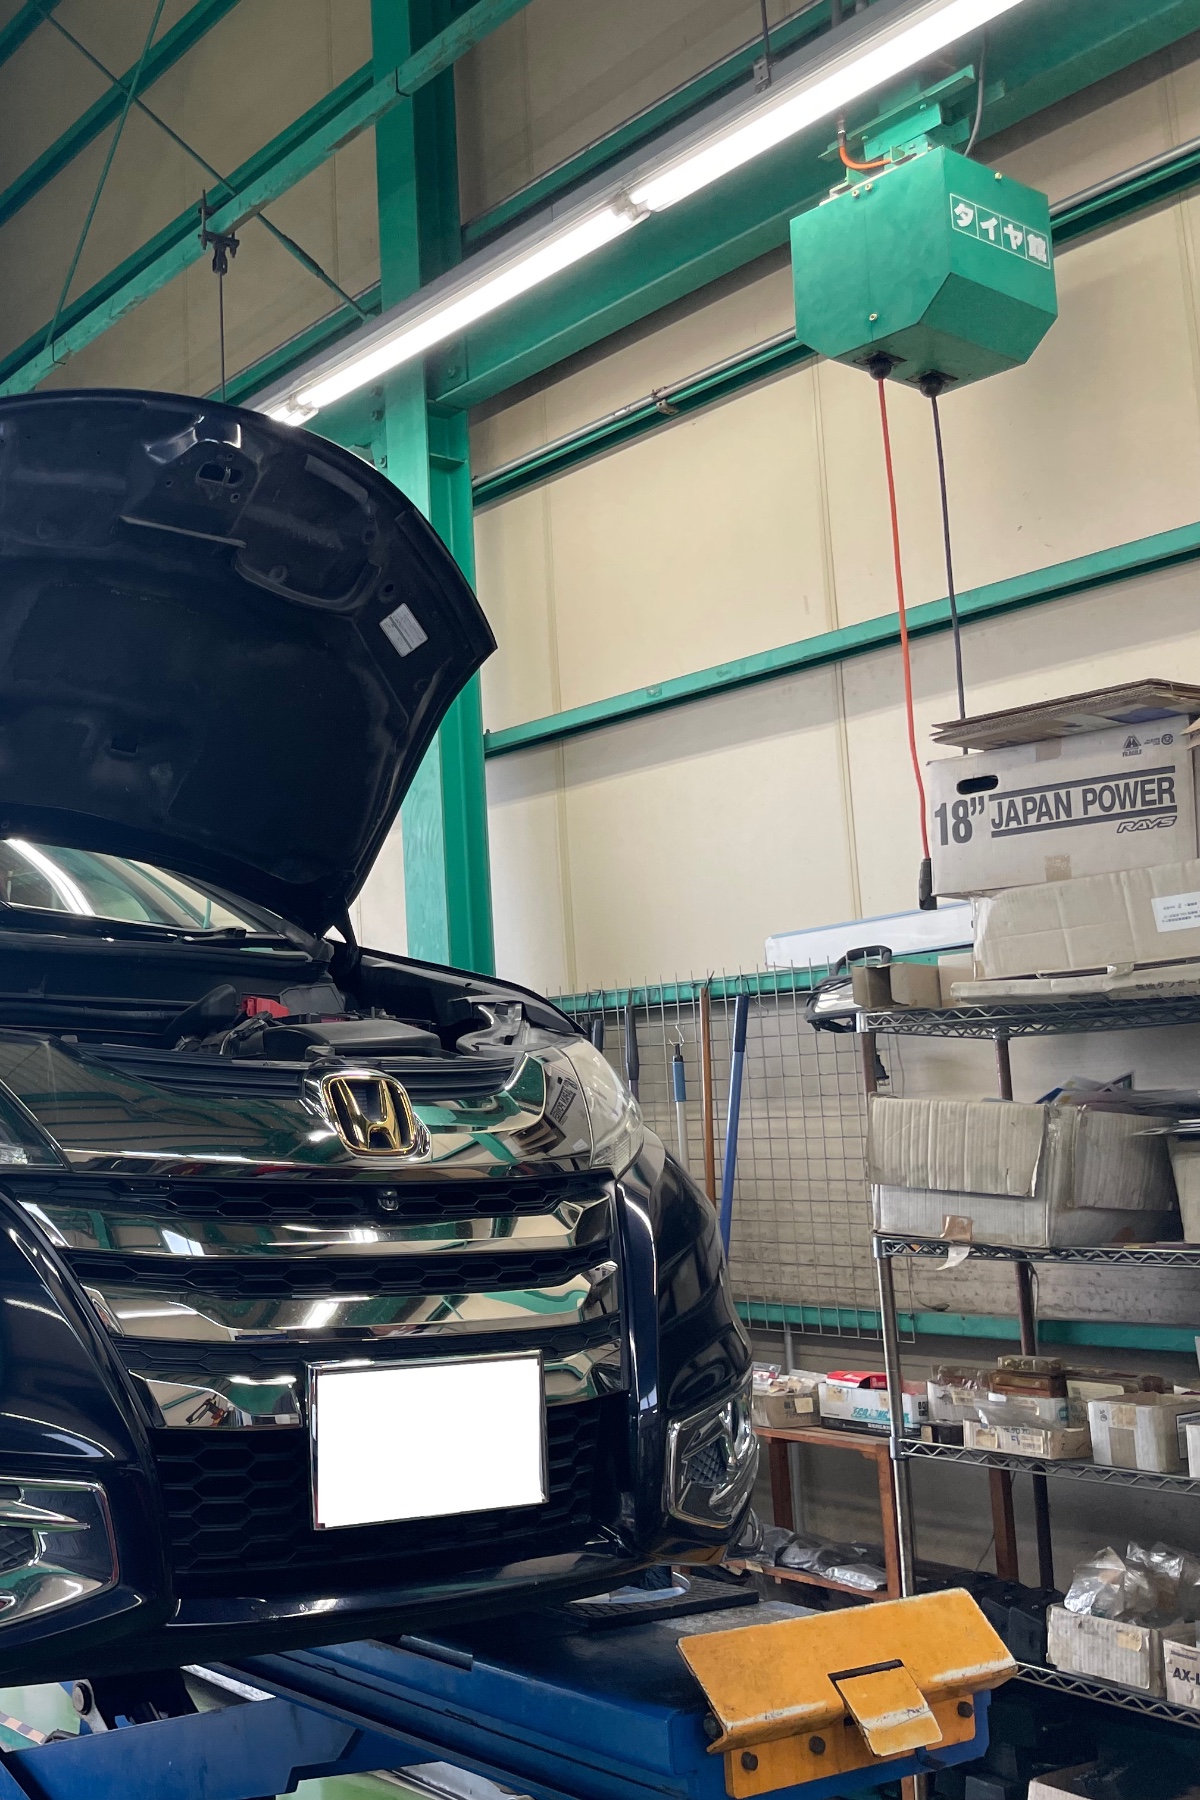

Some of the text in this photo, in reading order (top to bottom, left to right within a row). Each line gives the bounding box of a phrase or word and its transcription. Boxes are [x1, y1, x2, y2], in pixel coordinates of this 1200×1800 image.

[990, 790, 1073, 830] JAPAN
[1081, 776, 1176, 816] POWER
[1116, 815, 1178, 834] RAYS
